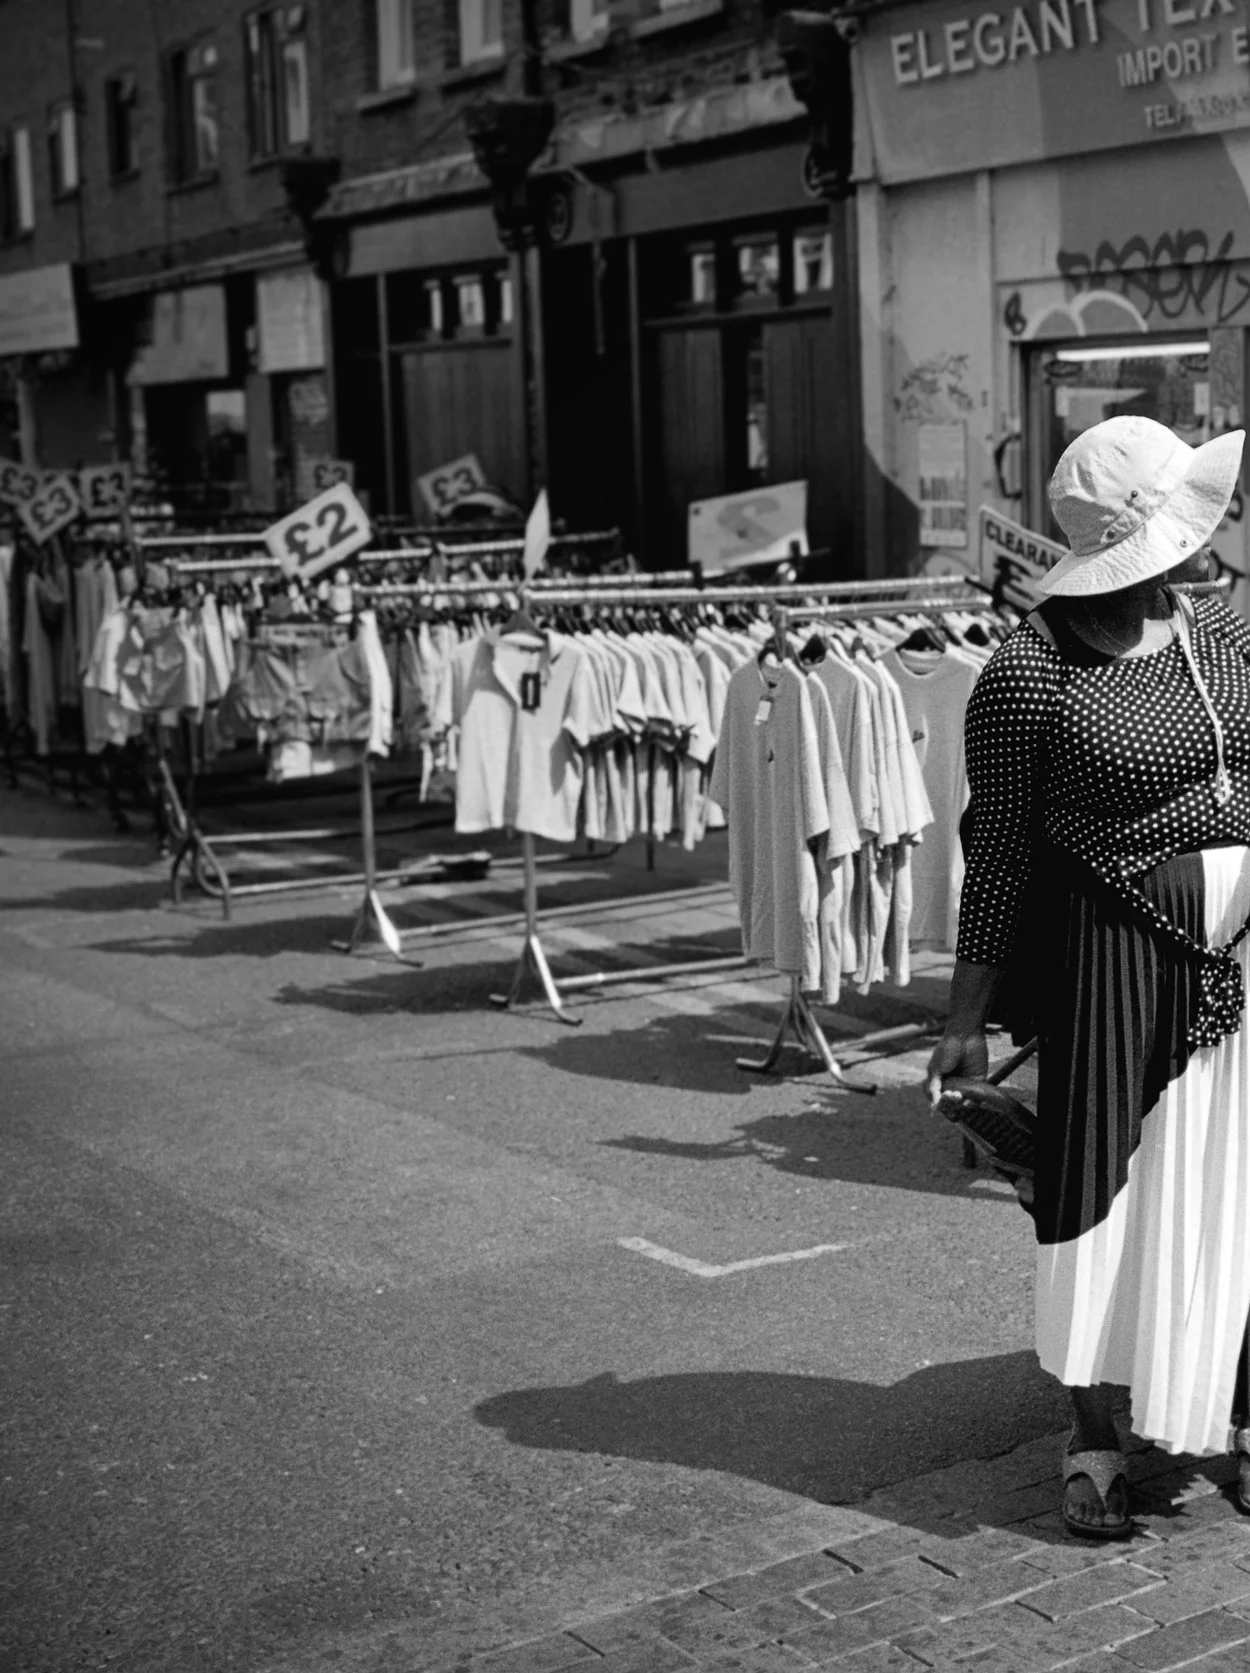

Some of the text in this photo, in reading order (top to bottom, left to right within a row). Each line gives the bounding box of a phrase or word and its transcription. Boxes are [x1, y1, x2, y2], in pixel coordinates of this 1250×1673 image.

[890, 0, 1101, 85] ELEGANT
[1116, 32, 1218, 87] IMPORT
[30, 486, 72, 529] £3
[431, 466, 478, 505] £3
[283, 501, 360, 563] £2
